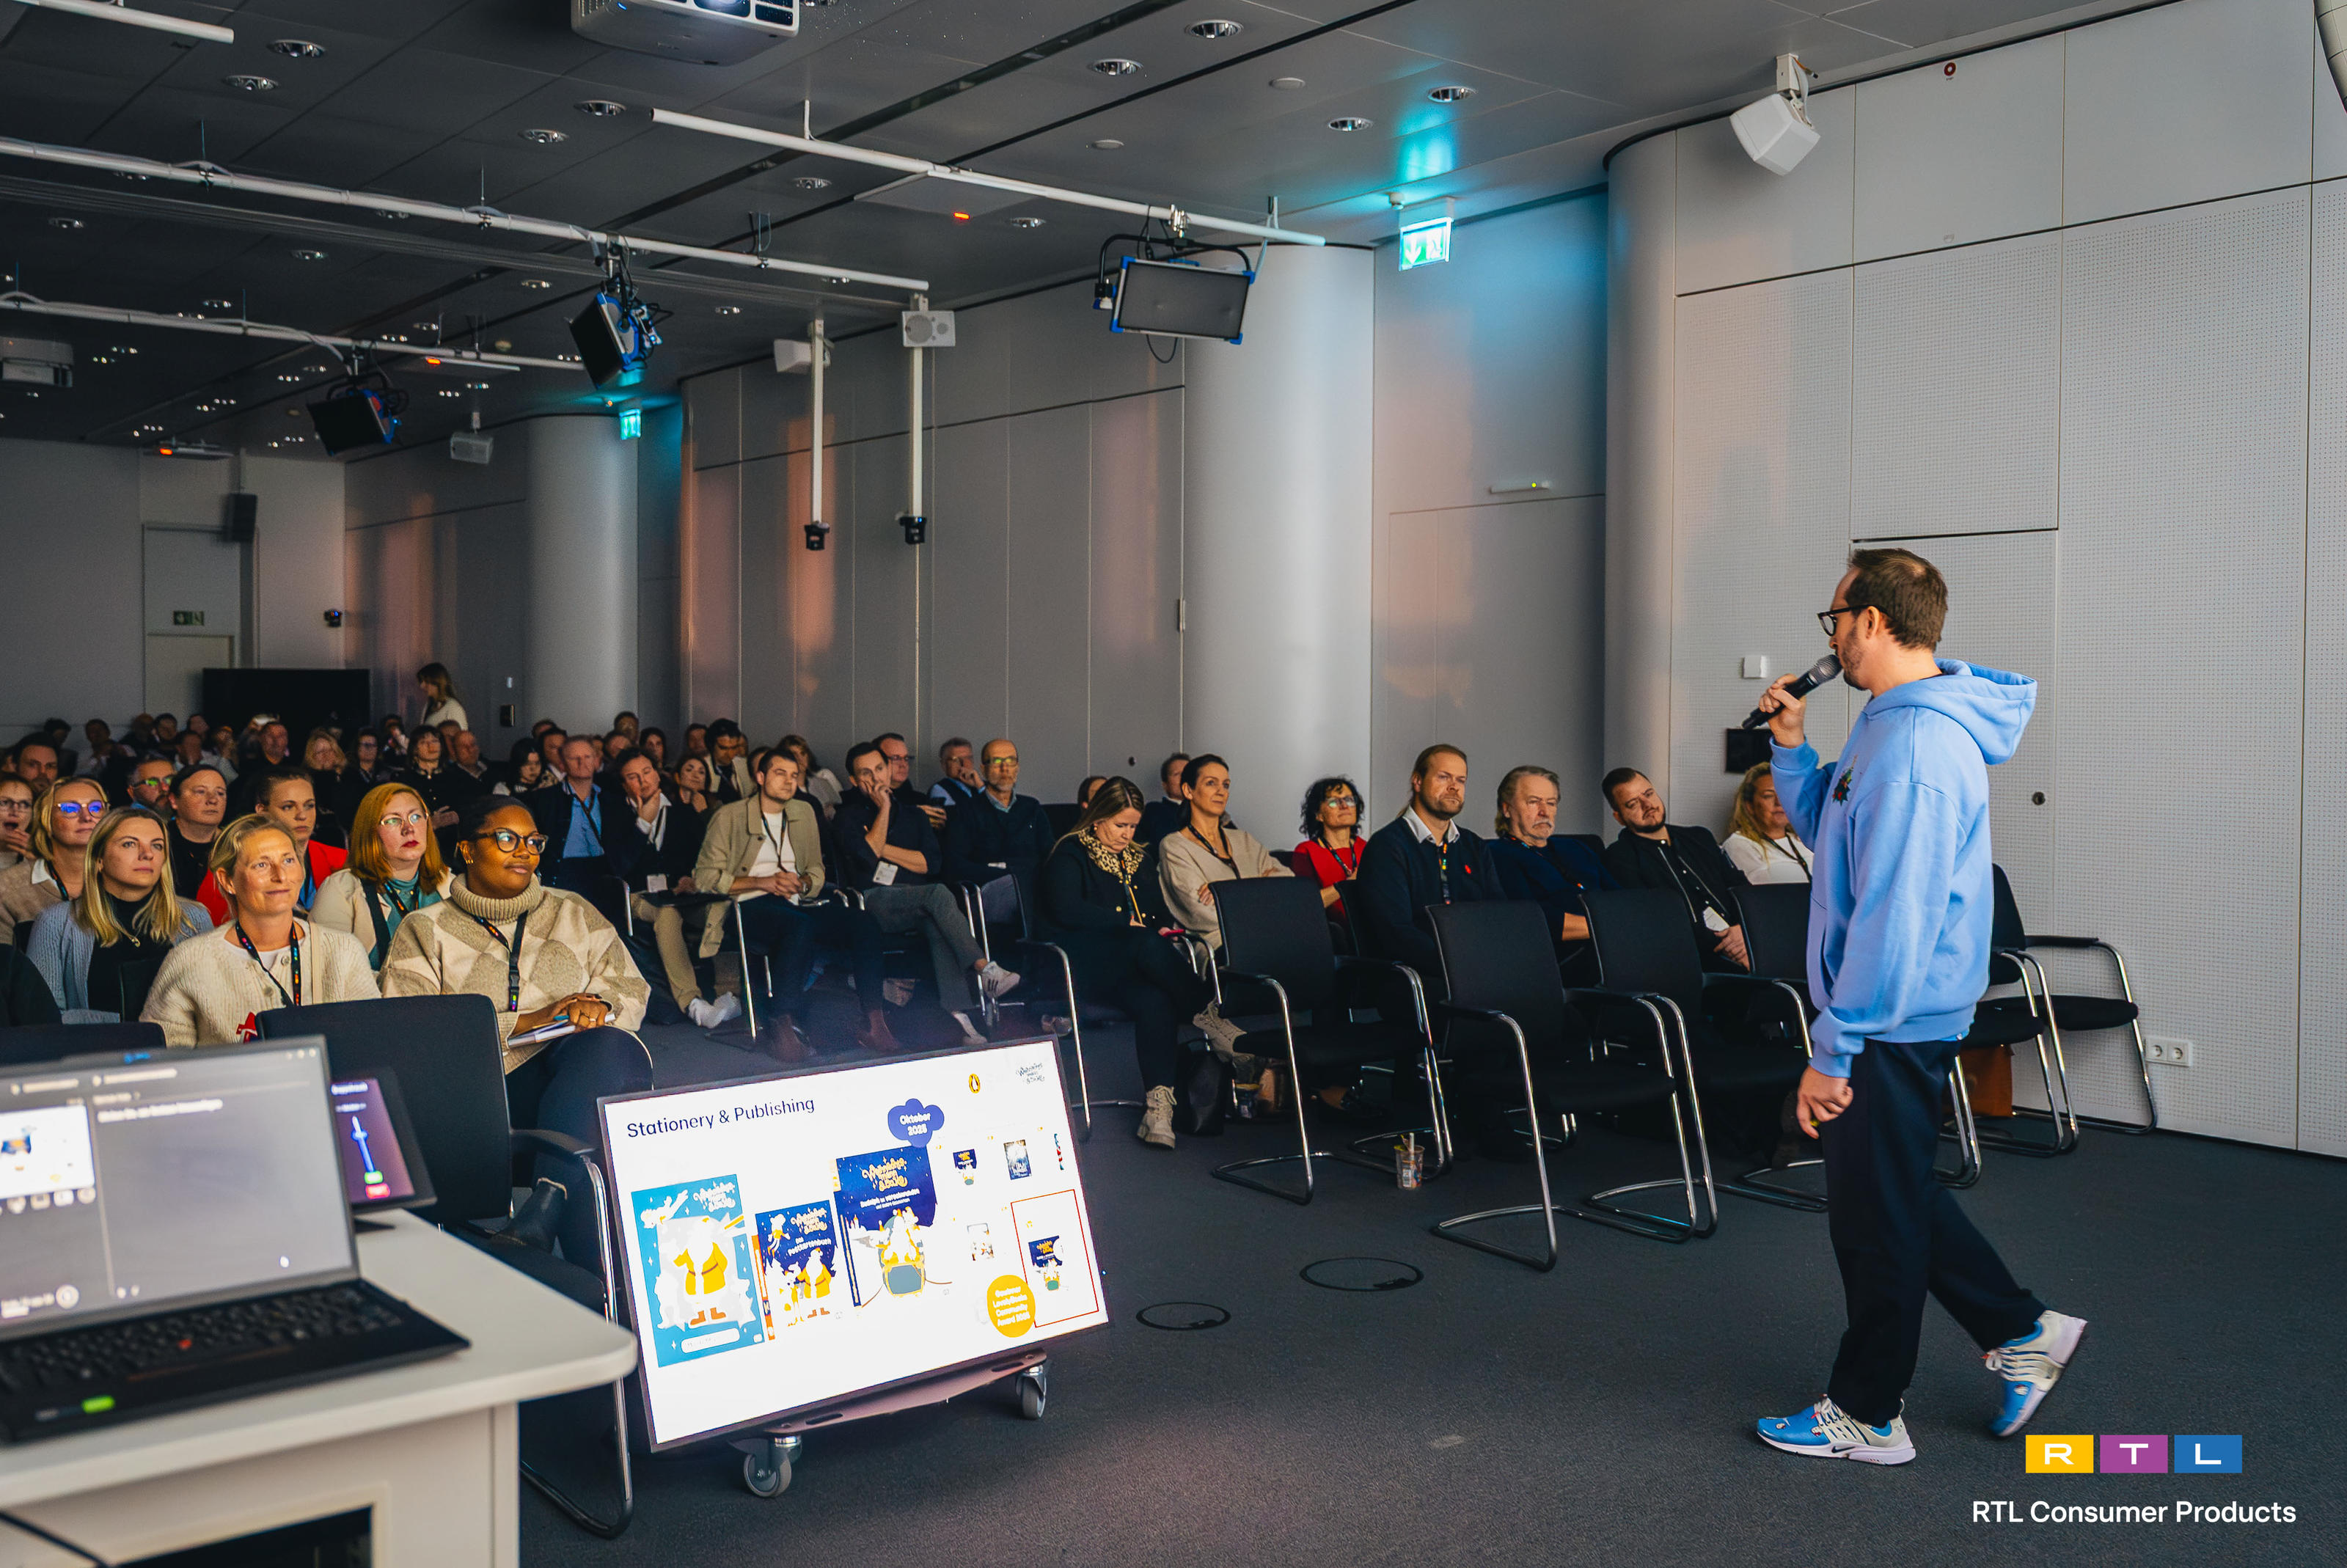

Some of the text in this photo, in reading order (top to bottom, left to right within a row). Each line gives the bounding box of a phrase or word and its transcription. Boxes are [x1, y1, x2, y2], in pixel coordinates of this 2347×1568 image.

[627, 1099, 815, 1137] Stationery & Publishing
[899, 1113, 931, 1125] Oktober
